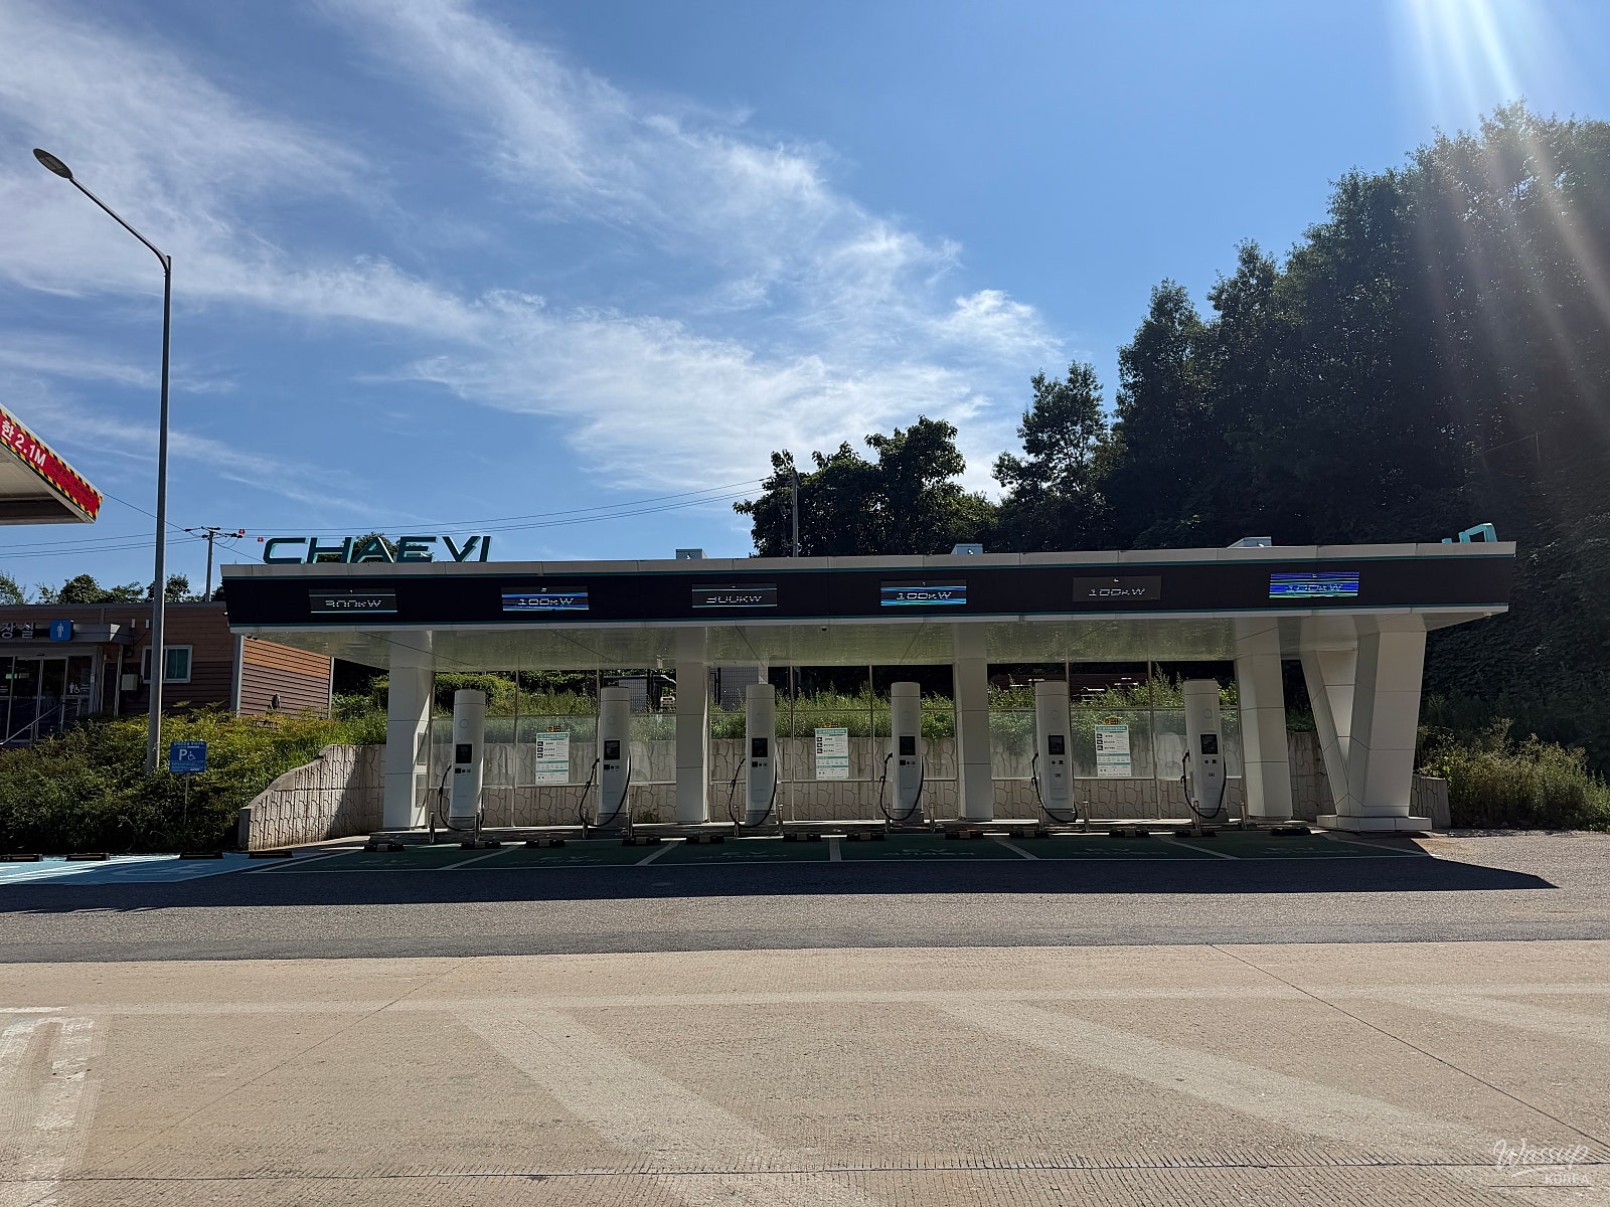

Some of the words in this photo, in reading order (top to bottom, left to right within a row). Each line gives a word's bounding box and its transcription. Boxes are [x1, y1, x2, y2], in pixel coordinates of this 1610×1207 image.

[2, 420, 14, 441] 한
[15, 434, 46, 467] 2.1M
[262, 536, 492, 564] CHAEVI
[179, 749, 188, 761] P
